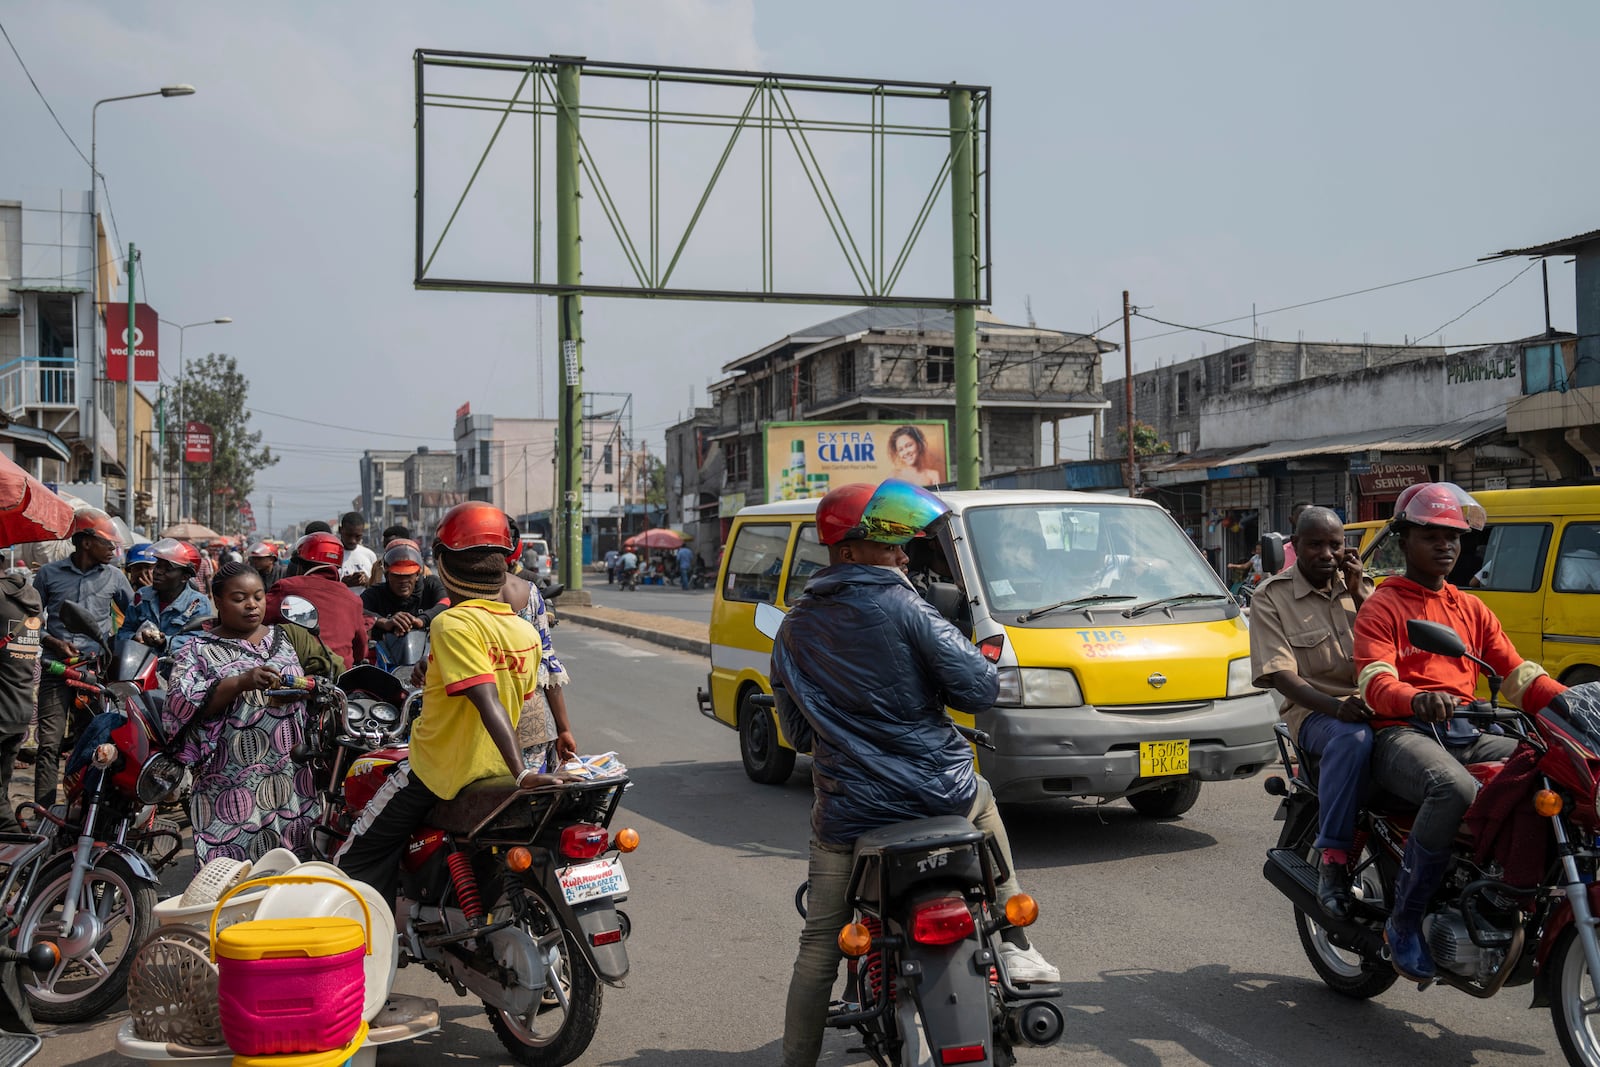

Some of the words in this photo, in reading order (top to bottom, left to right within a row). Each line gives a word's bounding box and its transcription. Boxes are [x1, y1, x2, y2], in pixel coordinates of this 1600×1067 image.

[110, 347, 155, 357] vodcom
[818, 431, 873, 443] EXTRA
[818, 443, 875, 462] CLAIR
[354, 761, 375, 777] TVS
[917, 853, 948, 873] TVS
